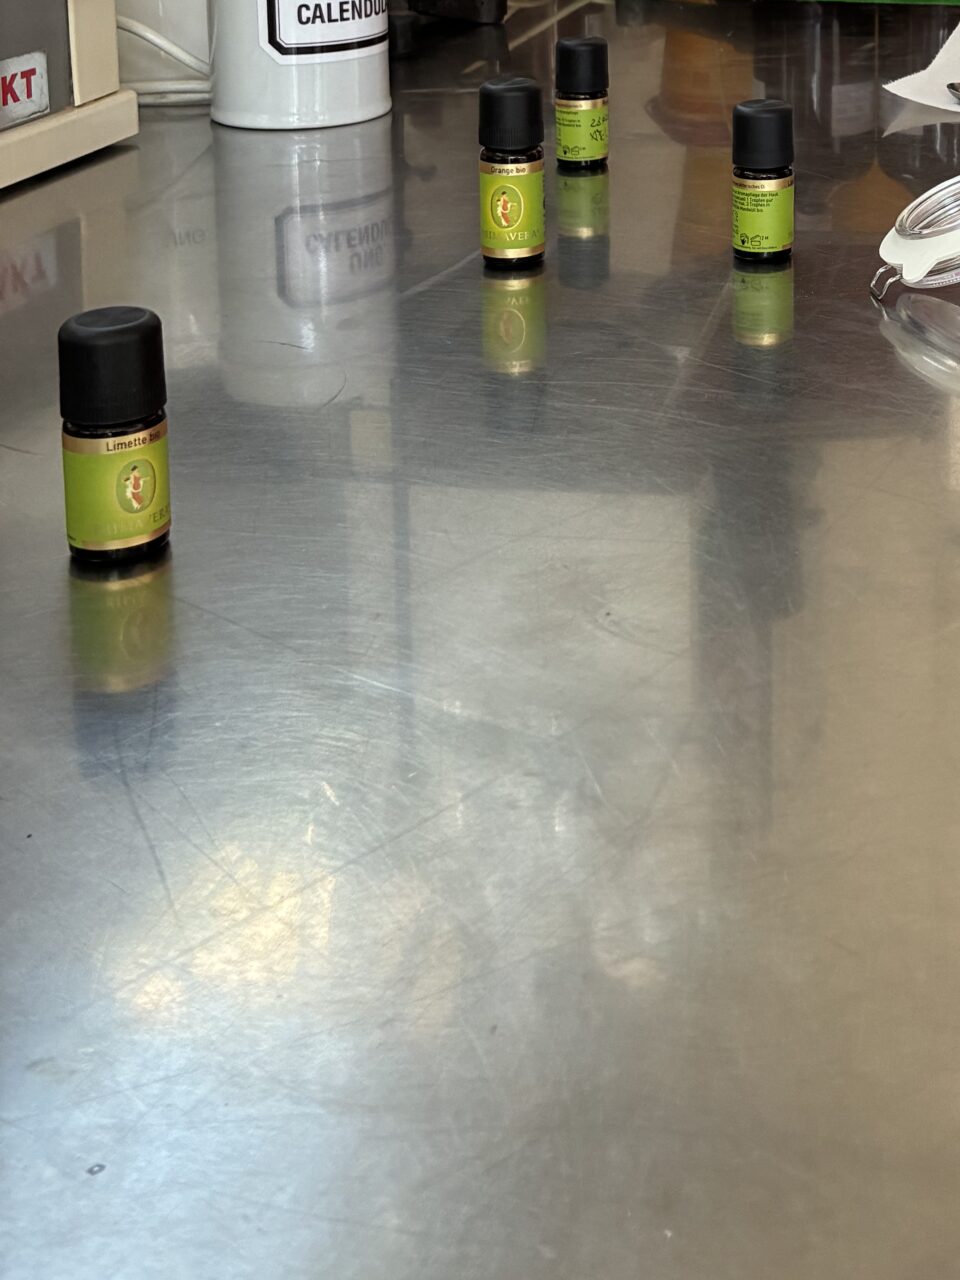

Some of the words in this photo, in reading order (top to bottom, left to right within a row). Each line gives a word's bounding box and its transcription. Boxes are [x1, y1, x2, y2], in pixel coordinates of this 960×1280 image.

[1, 67, 37, 107] KT
[490, 166, 515, 174] Orange
[106, 436, 147, 452] Limette
[149, 431, 161, 443] bio
